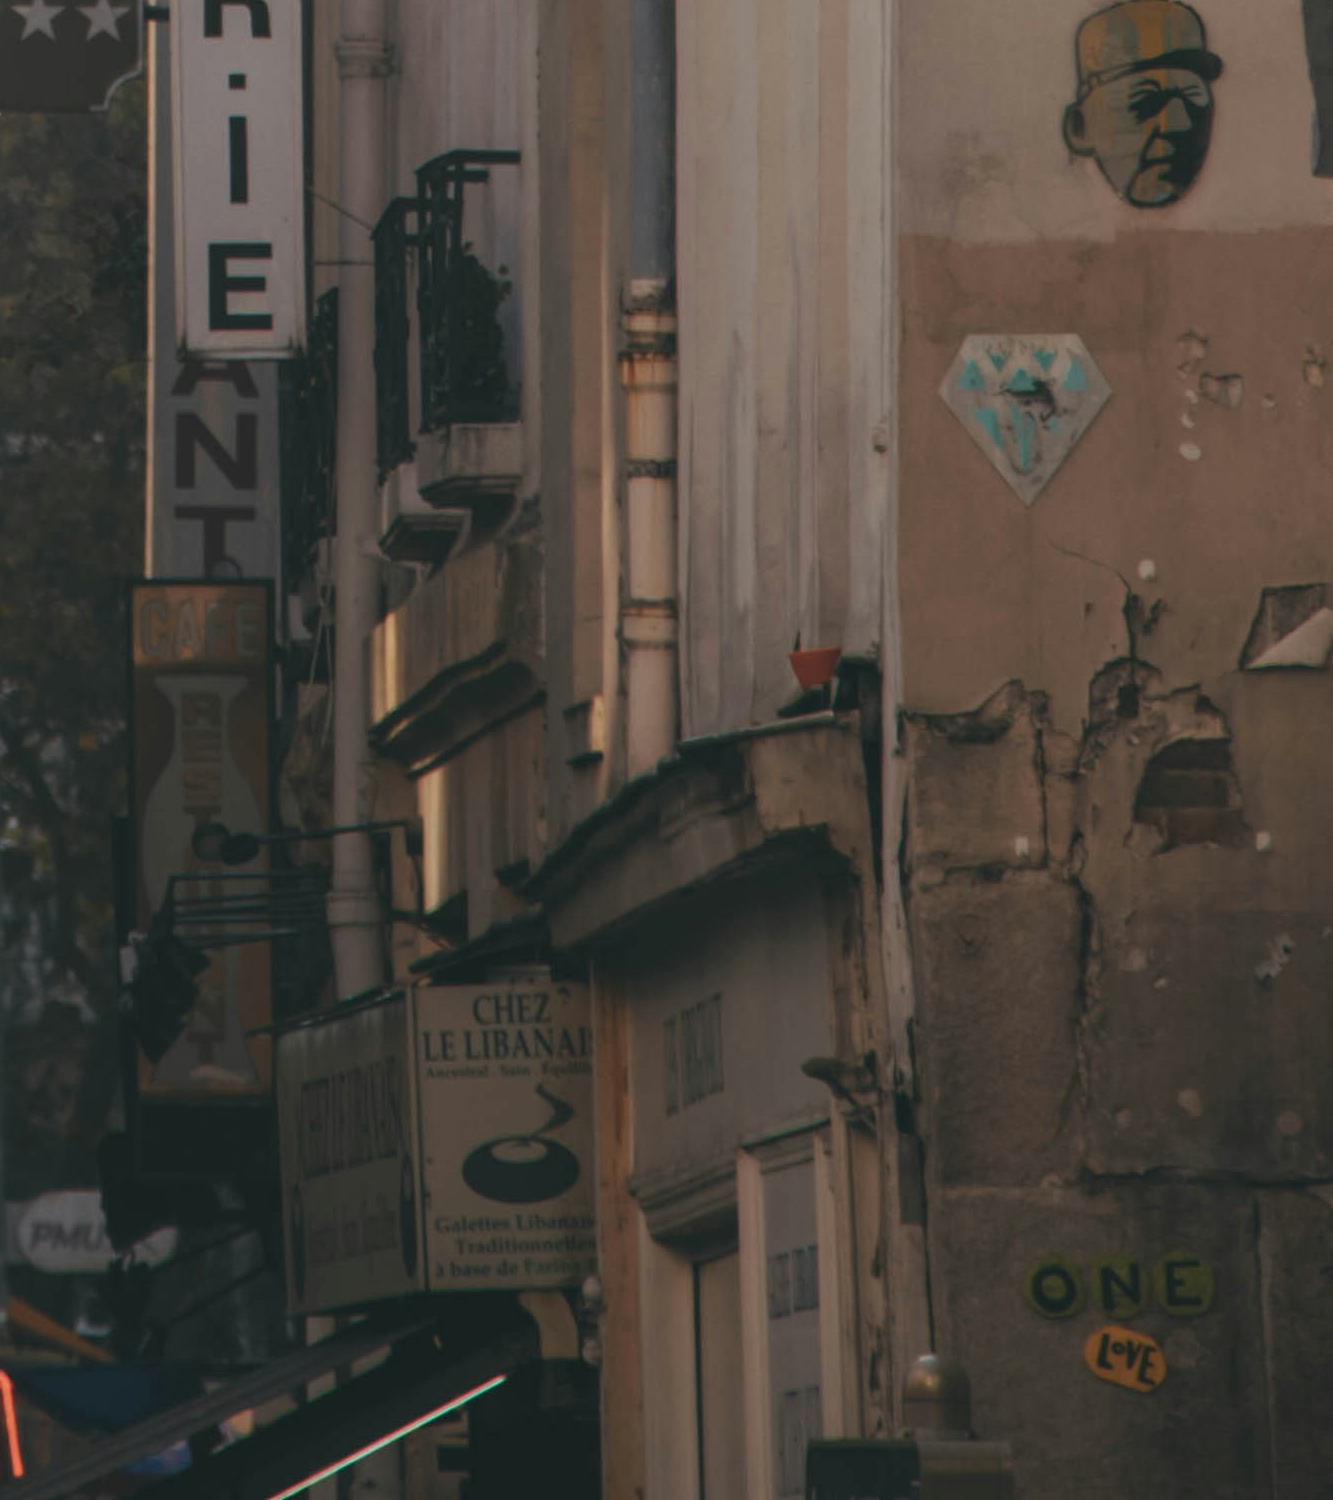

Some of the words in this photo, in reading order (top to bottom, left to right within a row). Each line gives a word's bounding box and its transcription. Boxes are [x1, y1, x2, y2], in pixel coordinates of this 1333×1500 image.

[472, 992, 552, 1025] CHEZ
[422, 1030, 455, 1062] LE
[434, 1215, 510, 1233] Galettes
[450, 1260, 491, 1277] base
[497, 1258, 518, 1276] de
[1031, 1259, 1204, 1313] ONE
[1096, 1333, 1158, 1386] LOVE
